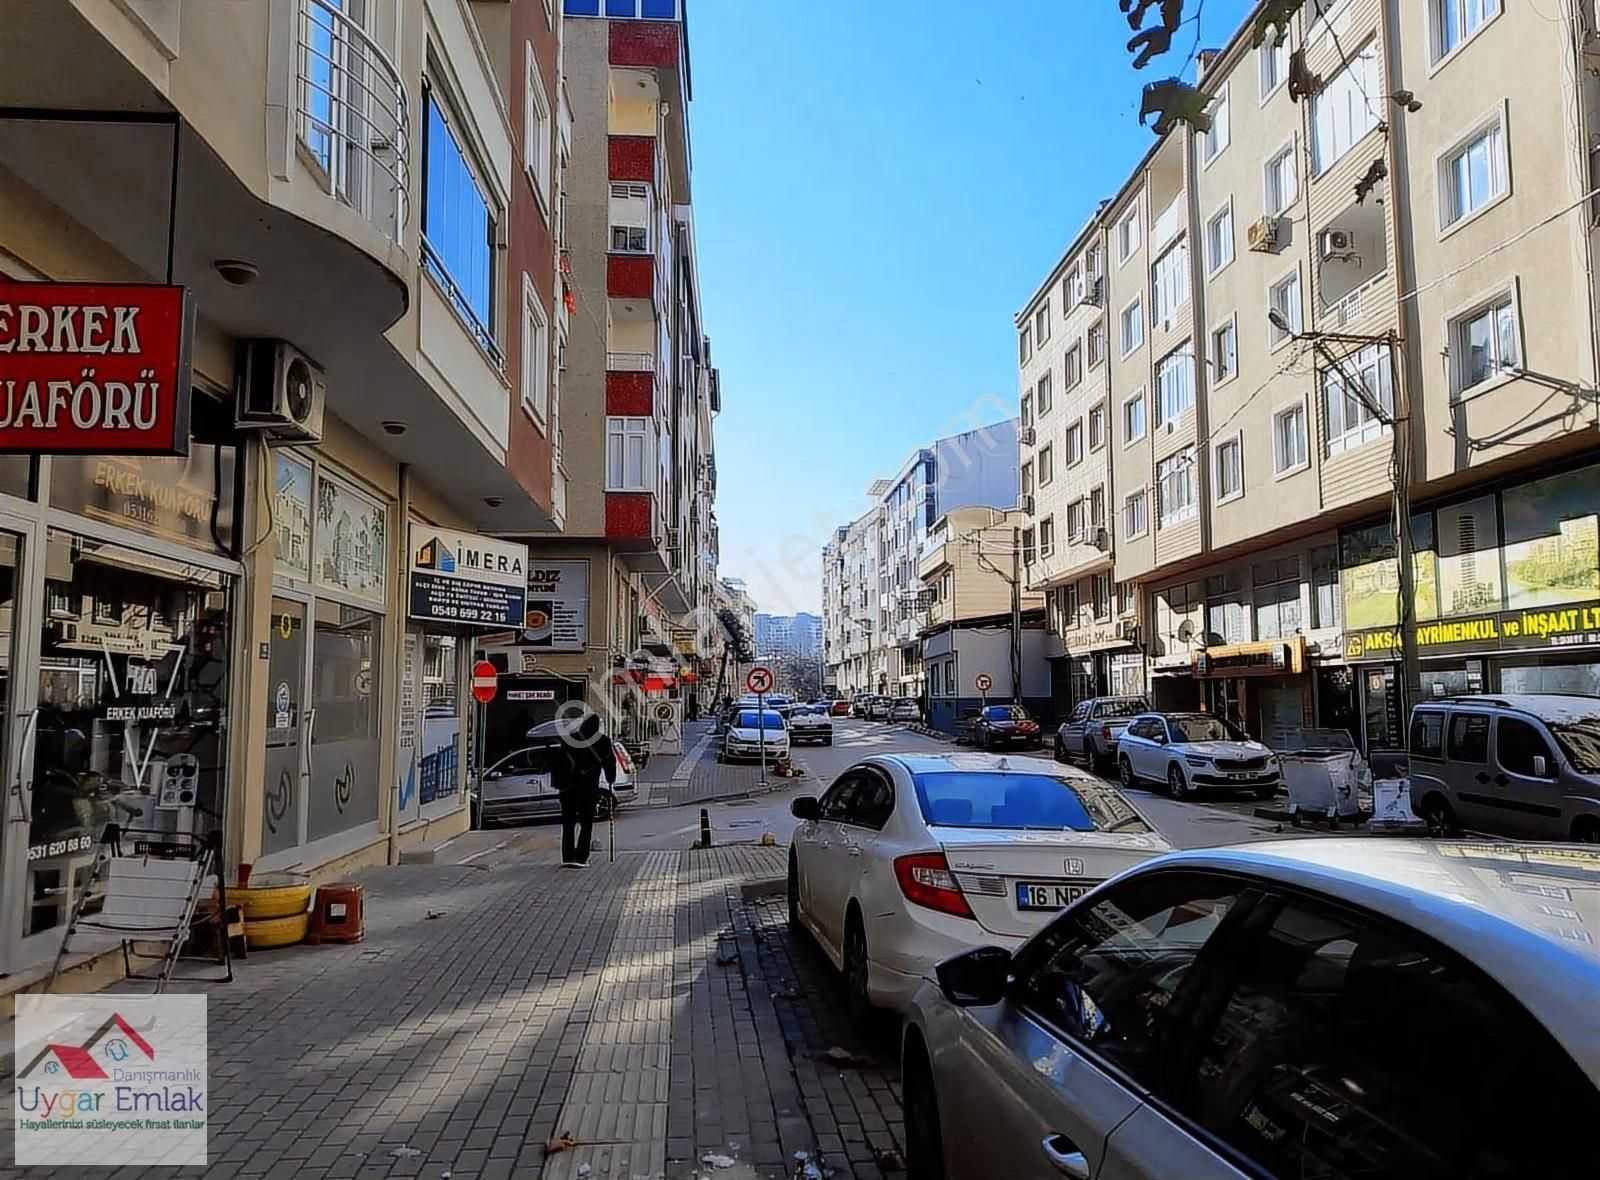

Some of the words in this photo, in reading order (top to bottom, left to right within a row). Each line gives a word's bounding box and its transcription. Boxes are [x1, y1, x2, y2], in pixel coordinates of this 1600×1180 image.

[0, 304, 140, 354] ERKEK
[457, 540, 522, 574] İMERA
[480, 610, 493, 620] 22
[1416, 619, 1499, 646] AYRİMENKUL
[1503, 621, 1520, 637] ve
[1522, 609, 1579, 639] İNŞAAT
[106, 706, 135, 720] ERKEK
[137, 703, 176, 720] KUAFÖRÜ
[1028, 886, 1047, 906] 16
